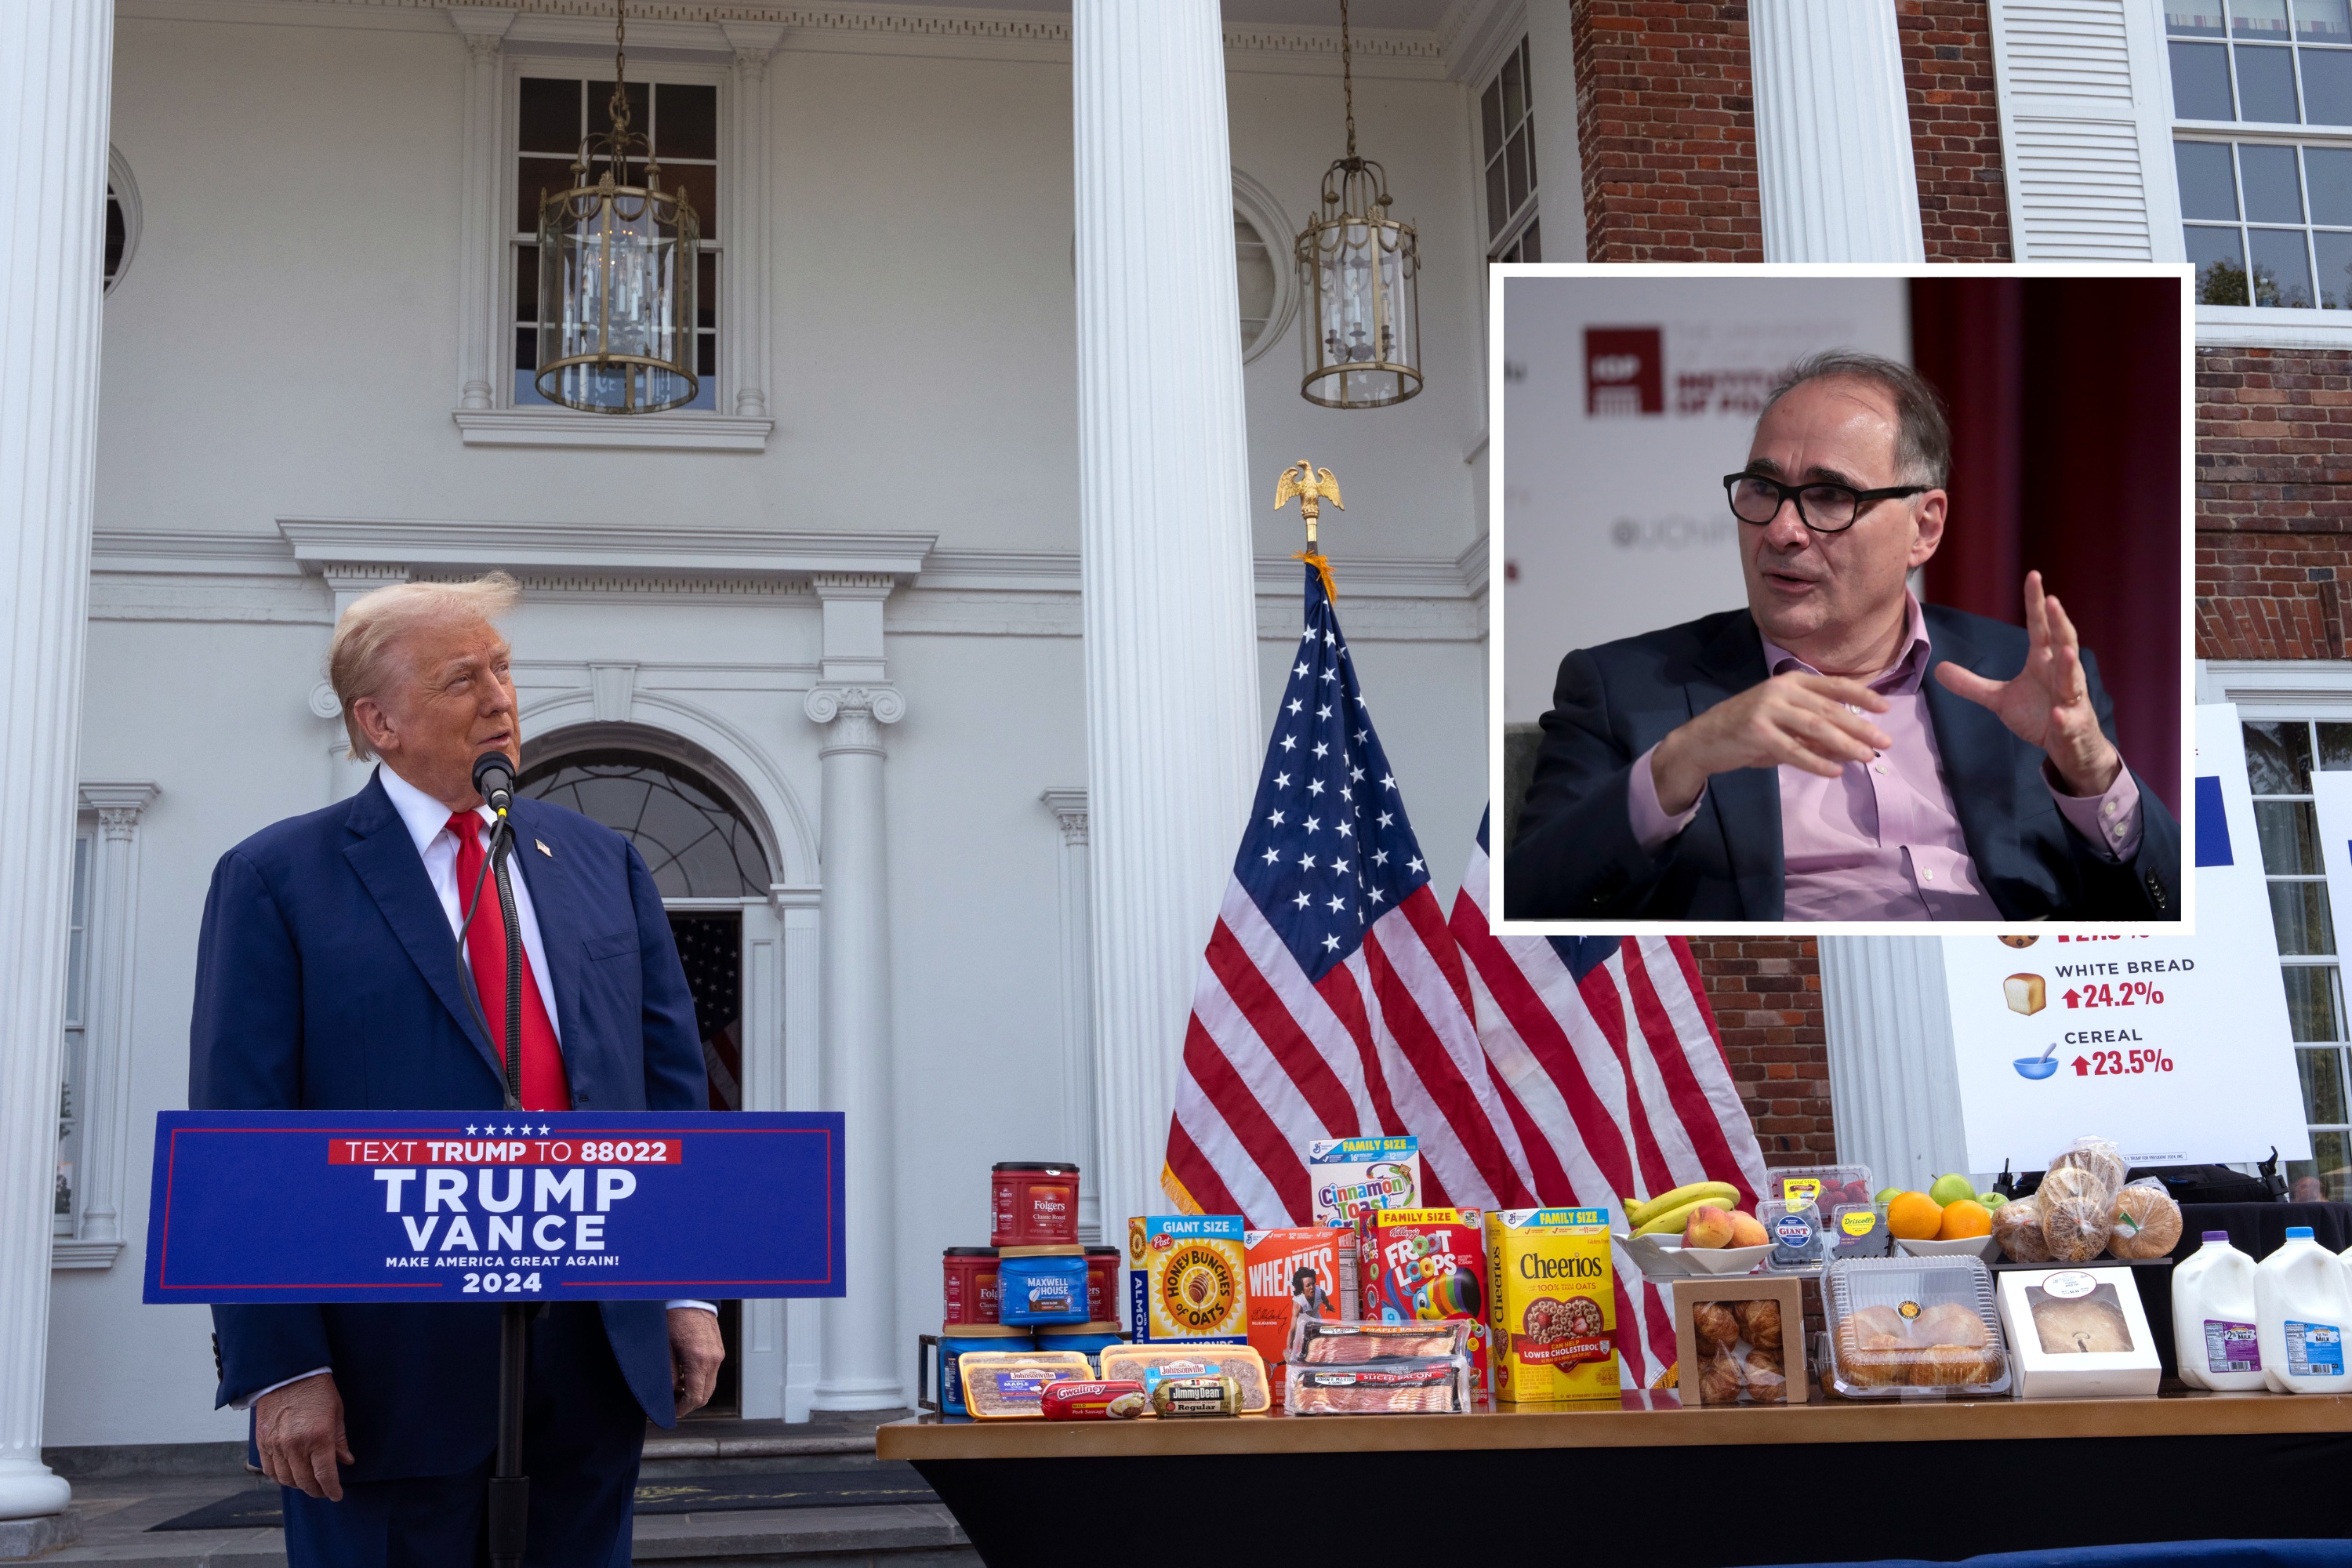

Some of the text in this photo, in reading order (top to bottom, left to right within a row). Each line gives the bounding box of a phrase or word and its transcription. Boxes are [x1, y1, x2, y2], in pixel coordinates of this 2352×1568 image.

[2055, 959, 2194, 978] WHITE BREAD
[2083, 981, 2165, 1008] 24.2%
[2064, 1029, 2143, 1044] CEREAL
[2092, 1048, 2174, 1076] 23.5%
[345, 1142, 666, 1162] TEXT TRUMP TO 88022
[1343, 1139, 1406, 1152] FAMILY SIZE
[374, 1168, 637, 1213] TRUMP
[1321, 1178, 1403, 1206] Cinnamon
[1034, 1200, 1065, 1212] Folgers
[1384, 1212, 1451, 1222] FAMILY SIZE
[1540, 1211, 1598, 1225] FAMILY SIZE
[401, 1214, 605, 1252] VANCE
[1163, 1221, 1229, 1232] GIANT SIZE
[1390, 1226, 1420, 1239] Kellogg's
[1153, 1236, 1171, 1248] Post
[1385, 1229, 1452, 1269] FROOT
[386, 1255, 619, 1268] MAKE AMERICA GREAT AGAIN!
[1520, 1252, 1602, 1279] Cheerios
[1167, 1250, 1230, 1298] HONEY BUNCHES
[1395, 1253, 1457, 1287] LOOPS
[463, 1272, 543, 1293] 2024
[1028, 1277, 1068, 1287] MAXWELL
[1493, 1246, 1504, 1323] Cheerios
[980, 1288, 998, 1301] Folg
[1041, 1287, 1069, 1295] HOUSE
[1176, 1302, 1225, 1326] of OATS
[1551, 1343, 1597, 1356] CHOLESTEROL
[1162, 1366, 1203, 1375] Johnsonville
[1058, 1385, 1105, 1399] Gwaltney
[1173, 1387, 1220, 1399] Jimmy Dean
